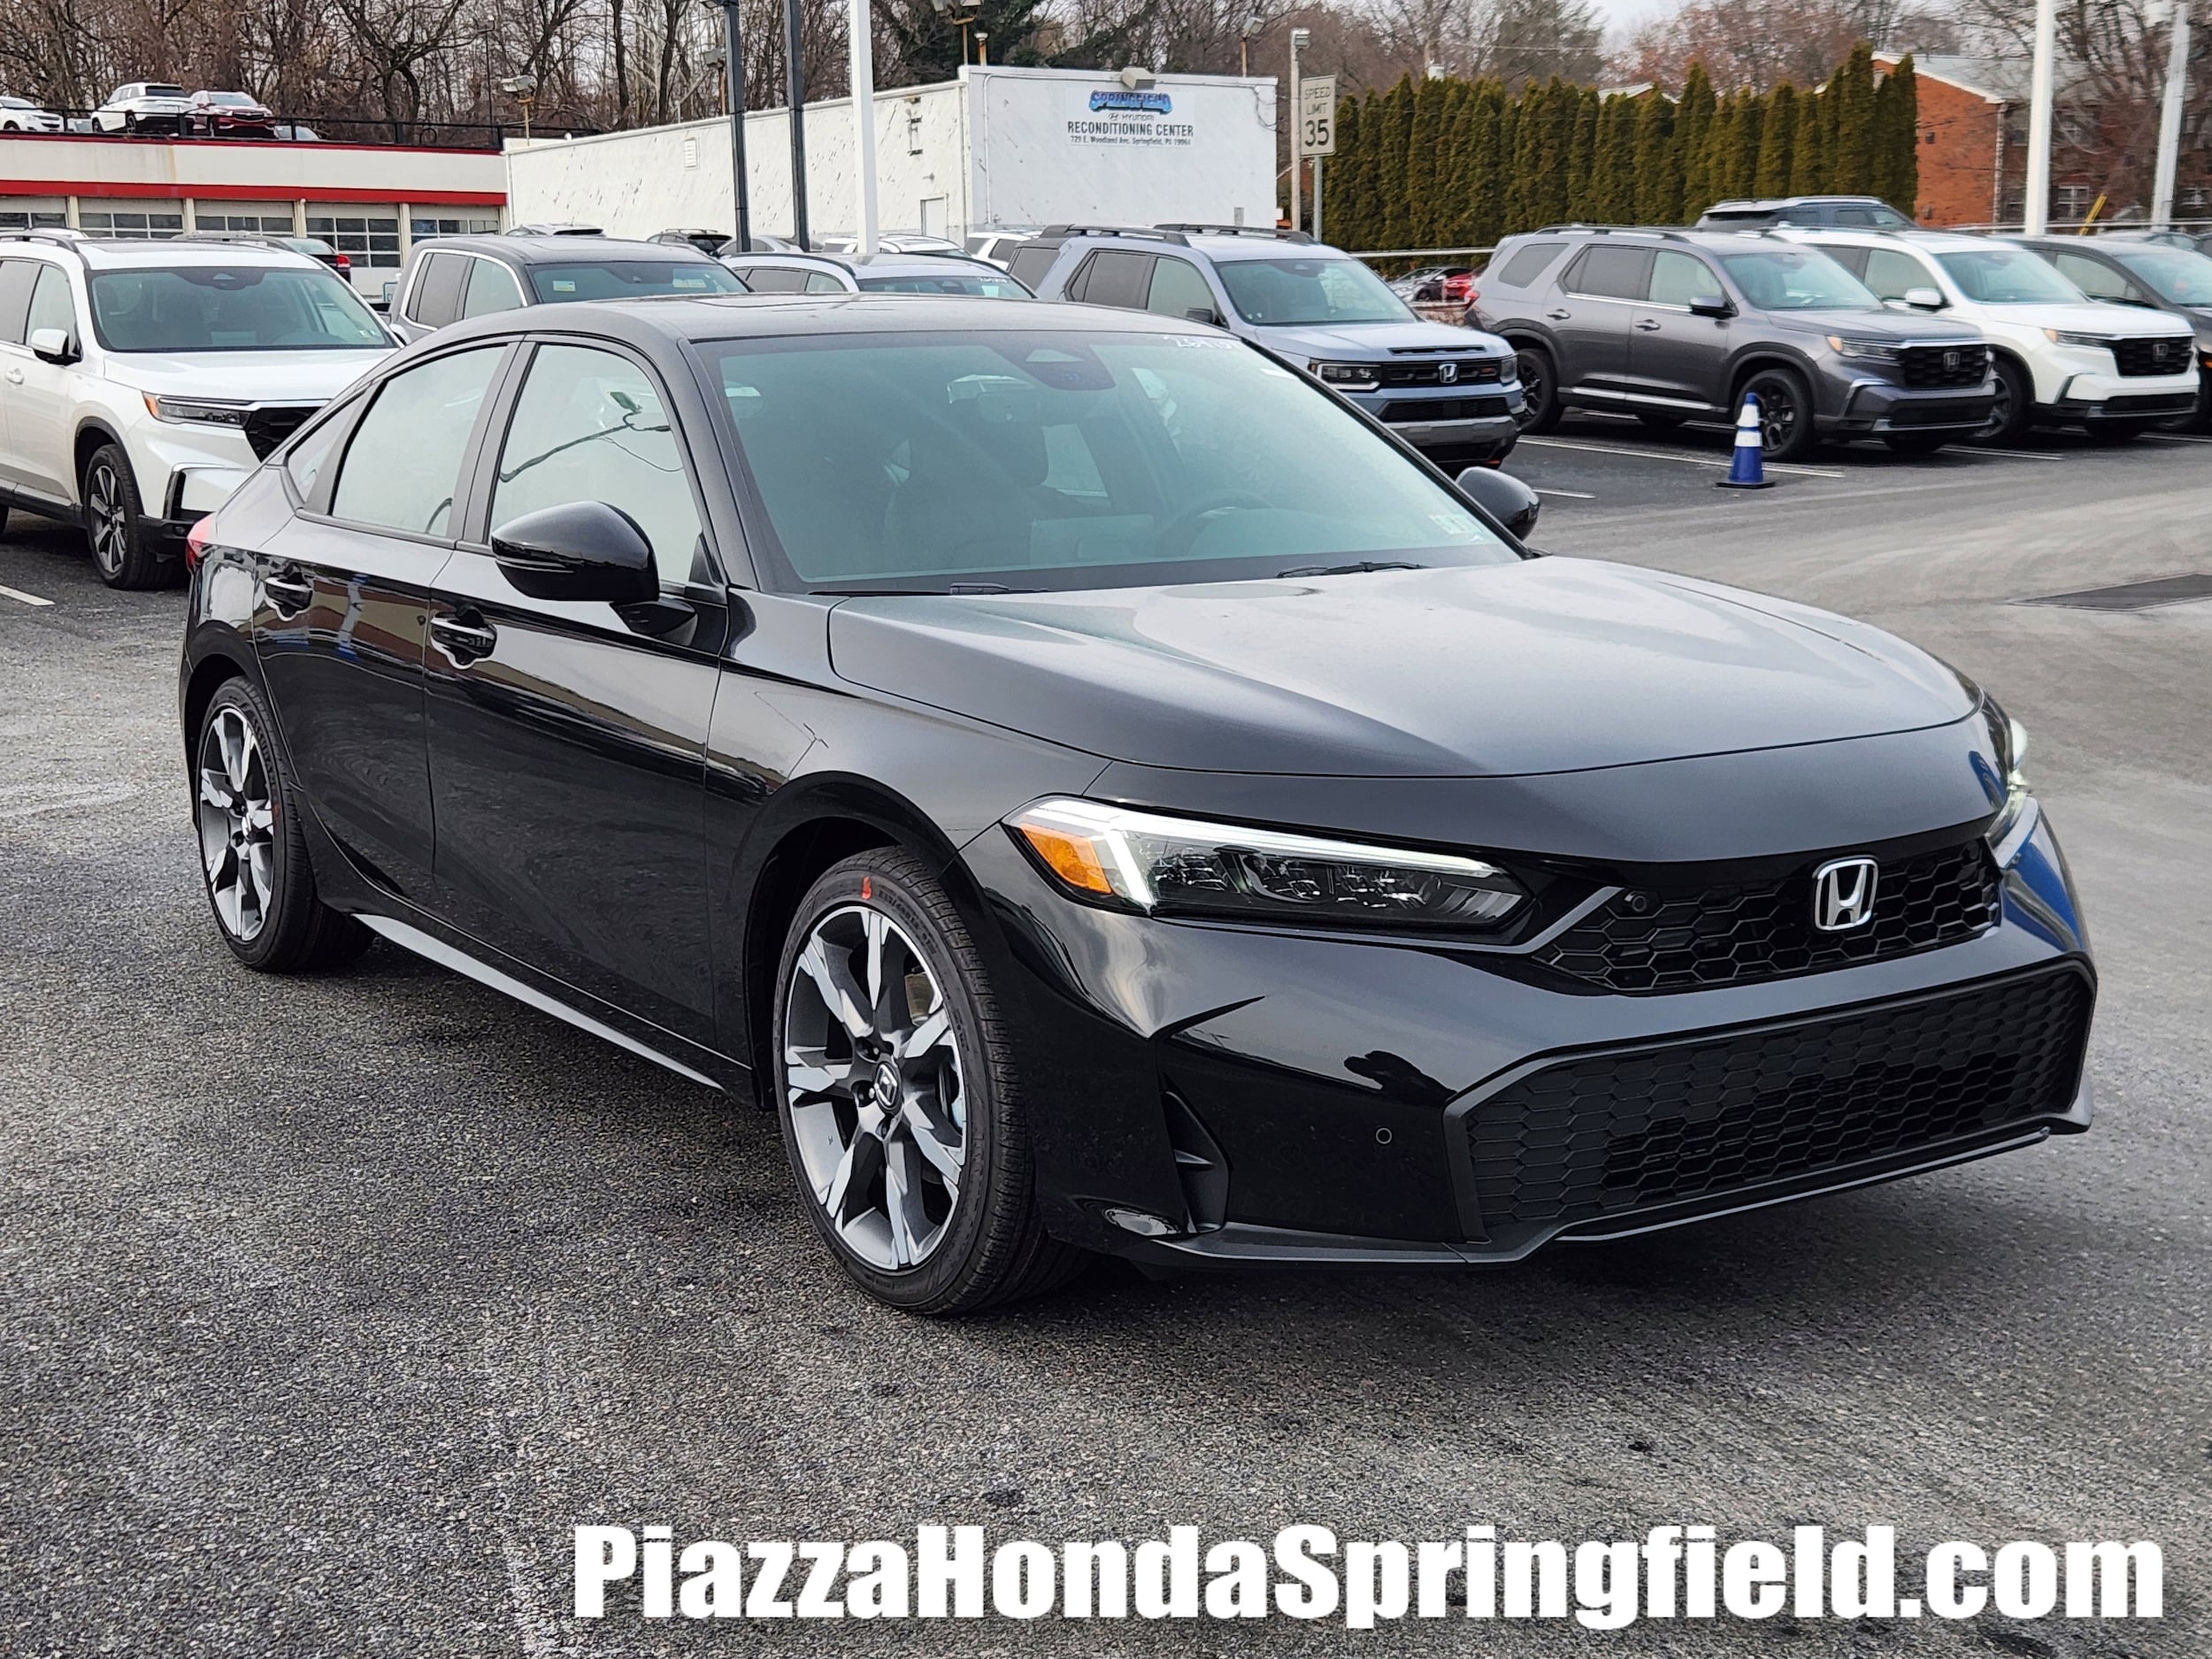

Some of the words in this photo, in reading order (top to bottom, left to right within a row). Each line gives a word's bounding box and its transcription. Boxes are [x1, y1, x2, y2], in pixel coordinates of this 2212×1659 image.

[1304, 86, 1331, 100] SPEED
[1306, 103, 1327, 115] LIMIT
[1067, 121, 1153, 135] RECONDITIONING
[1156, 124, 1194, 137] CENTER
[1304, 119, 1330, 147] 35
